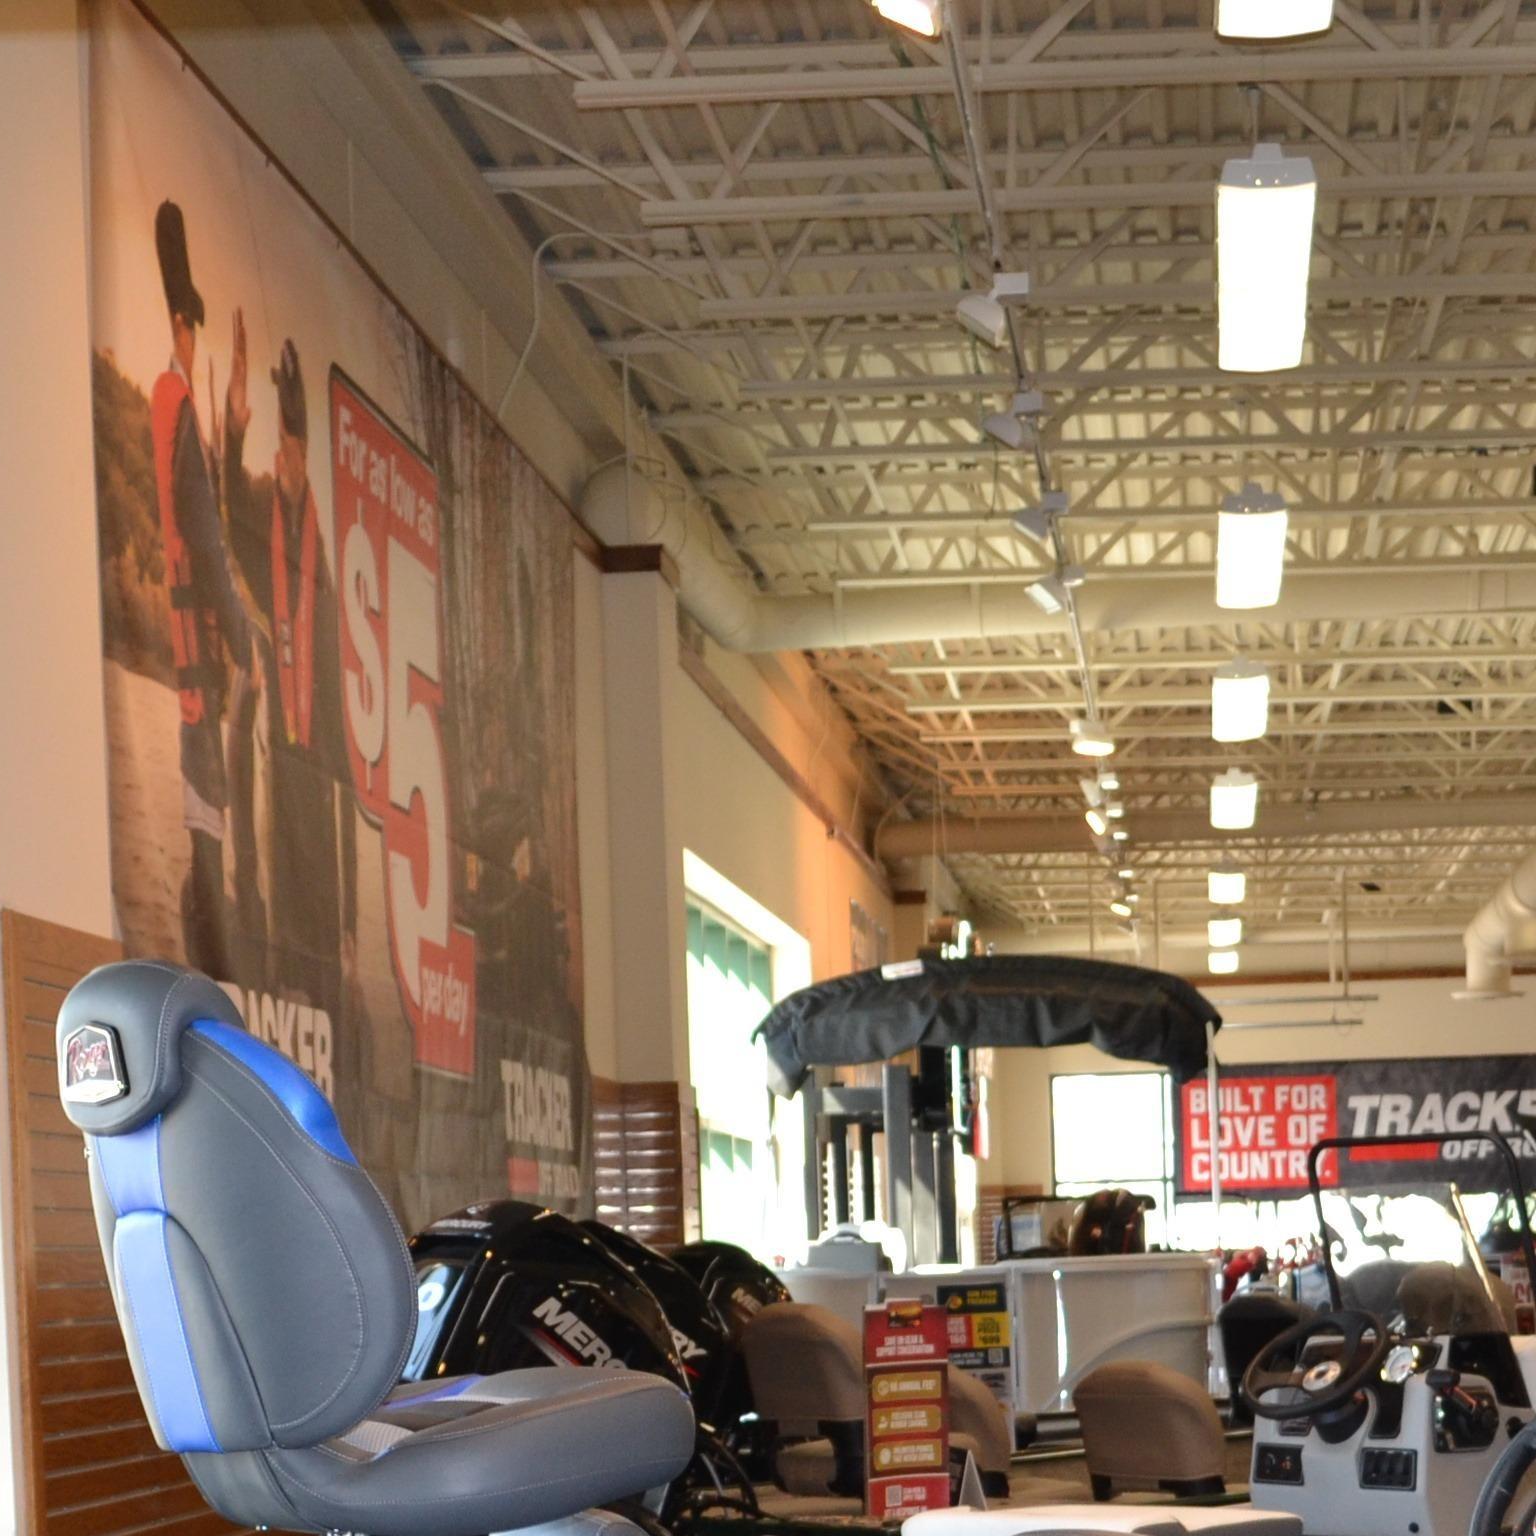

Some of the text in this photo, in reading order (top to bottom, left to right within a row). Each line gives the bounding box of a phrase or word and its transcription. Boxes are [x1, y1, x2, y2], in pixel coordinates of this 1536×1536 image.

[1275, 1083, 1328, 1112] FOR
[1190, 1113, 1328, 1150] LOVE OF
